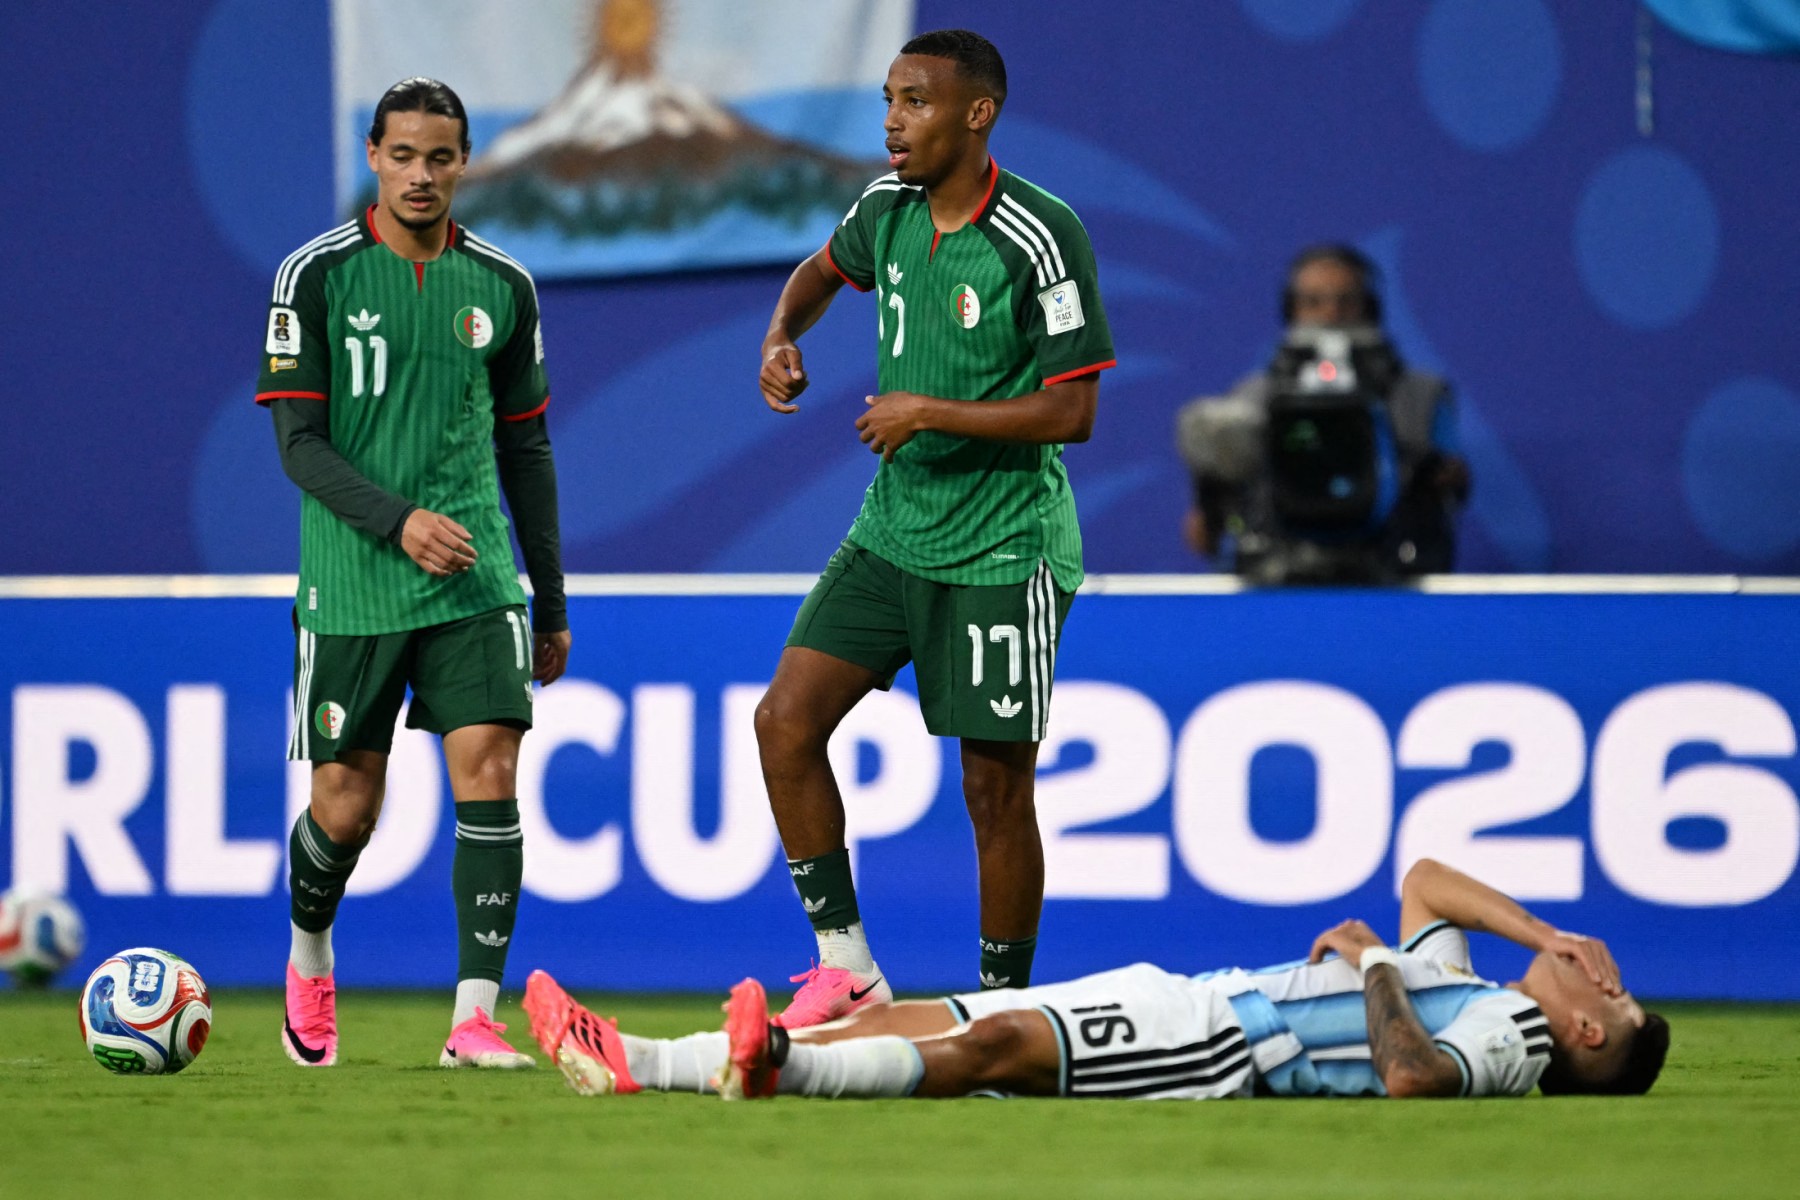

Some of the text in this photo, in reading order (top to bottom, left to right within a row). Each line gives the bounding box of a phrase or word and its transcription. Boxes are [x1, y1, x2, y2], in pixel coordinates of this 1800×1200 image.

[1055, 311, 1072, 322] PEACE
[345, 335, 387, 397] 11
[968, 624, 1022, 687] 17
[0, 678, 1799, 908] RLD CUP 2026
[476, 892, 511, 906] FAF
[1070, 1003, 1136, 1047] 16
